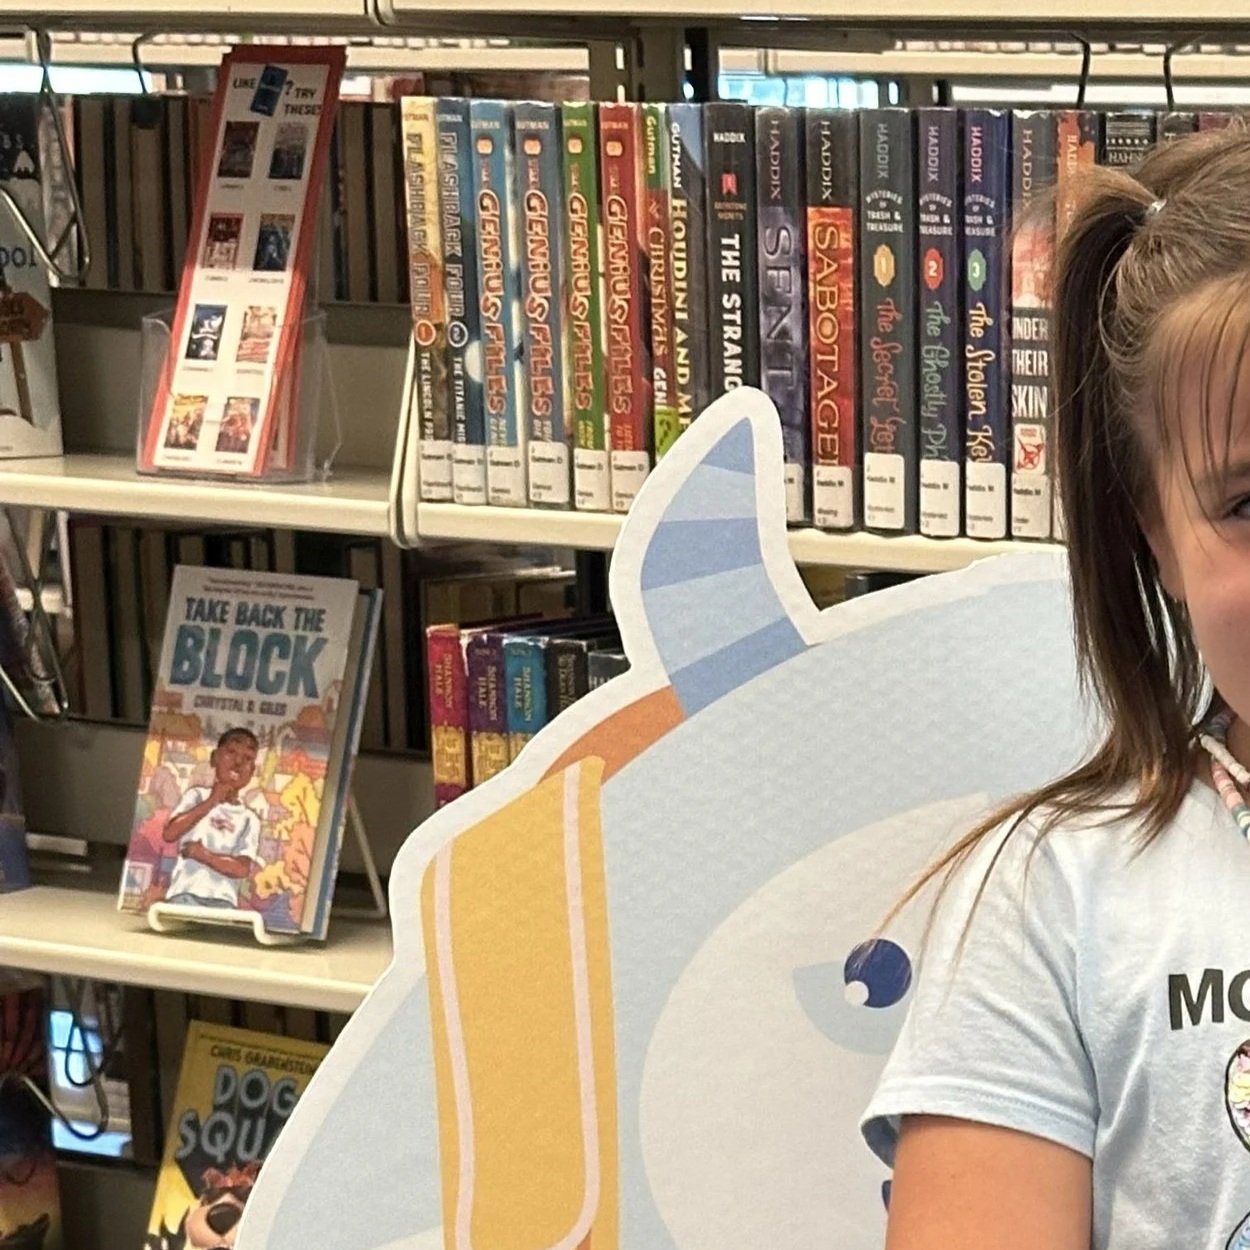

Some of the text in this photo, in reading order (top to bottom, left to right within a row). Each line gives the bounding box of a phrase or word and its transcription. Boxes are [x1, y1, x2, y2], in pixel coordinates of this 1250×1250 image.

[232, 77, 317, 99] LIKE TRY
[646, 115, 656, 174] Gutman
[671, 121, 682, 188] GUTMAN
[713, 132, 746, 143] HADDIX
[769, 120, 781, 199] HADDIX
[820, 121, 832, 200] HADDIX
[876, 123, 889, 179] HADDIX
[927, 126, 939, 182] HADDIX
[970, 126, 983, 183] HADDIX
[406, 133, 424, 258] FLASHBACK
[440, 132, 461, 256] FLASHBACK
[720, 234, 741, 283] THE
[671, 198, 692, 384] HOUDINI AND
[876, 297, 903, 333] The
[925, 301, 951, 337] The
[482, 322, 507, 414] FILES
[814, 224, 840, 466] SABOTAGE
[965, 302, 996, 420] The Stolen
[454, 380, 466, 418] TITANIC
[920, 343, 950, 419] Ghostly
[186, 597, 327, 633] TAKE BACK THE
[169, 623, 329, 699] BLOCK
[214, 1064, 300, 1118] DOG
